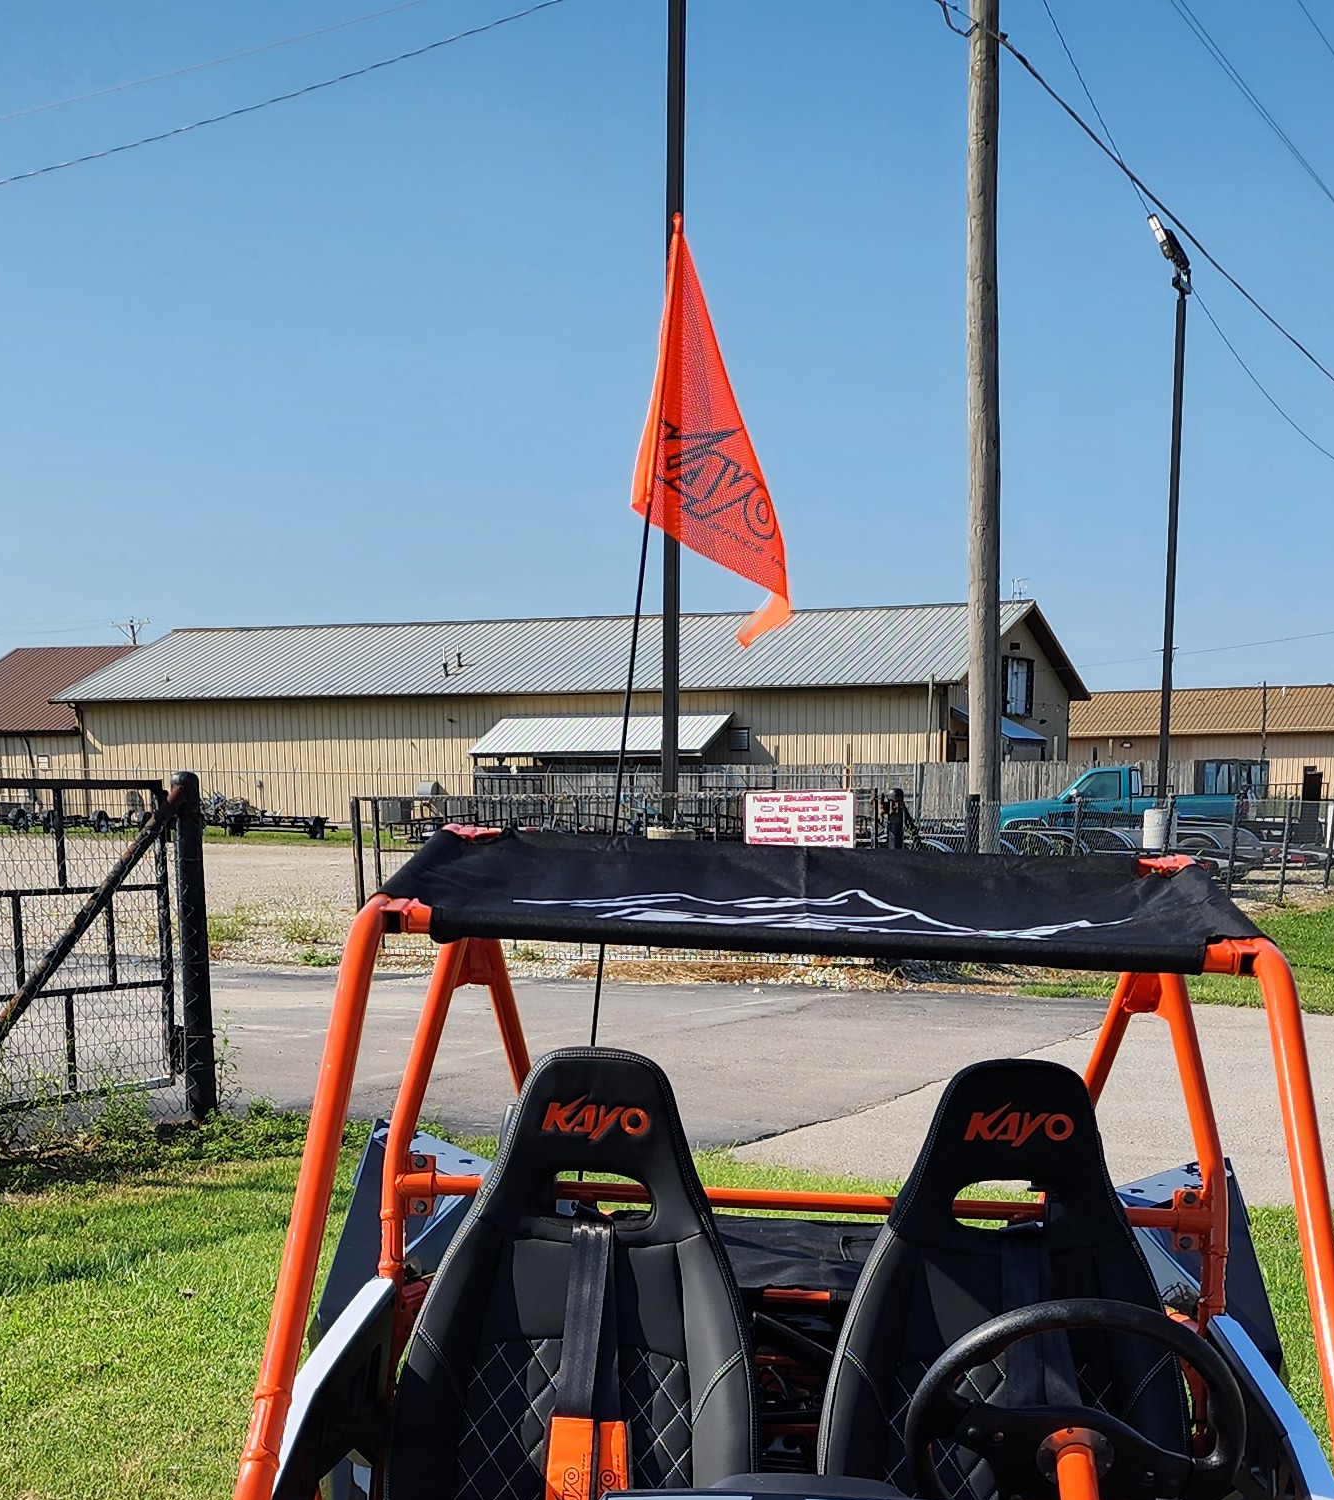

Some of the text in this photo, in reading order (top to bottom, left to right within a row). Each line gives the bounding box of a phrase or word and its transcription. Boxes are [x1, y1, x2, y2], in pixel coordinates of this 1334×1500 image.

[754, 815, 789, 824] Monday
[829, 814, 844, 822] PM
[755, 825, 792, 834] Tuesday
[835, 834, 850, 842] PM
[541, 1094, 649, 1141] KAYO
[964, 1102, 1074, 1147] KAYO
